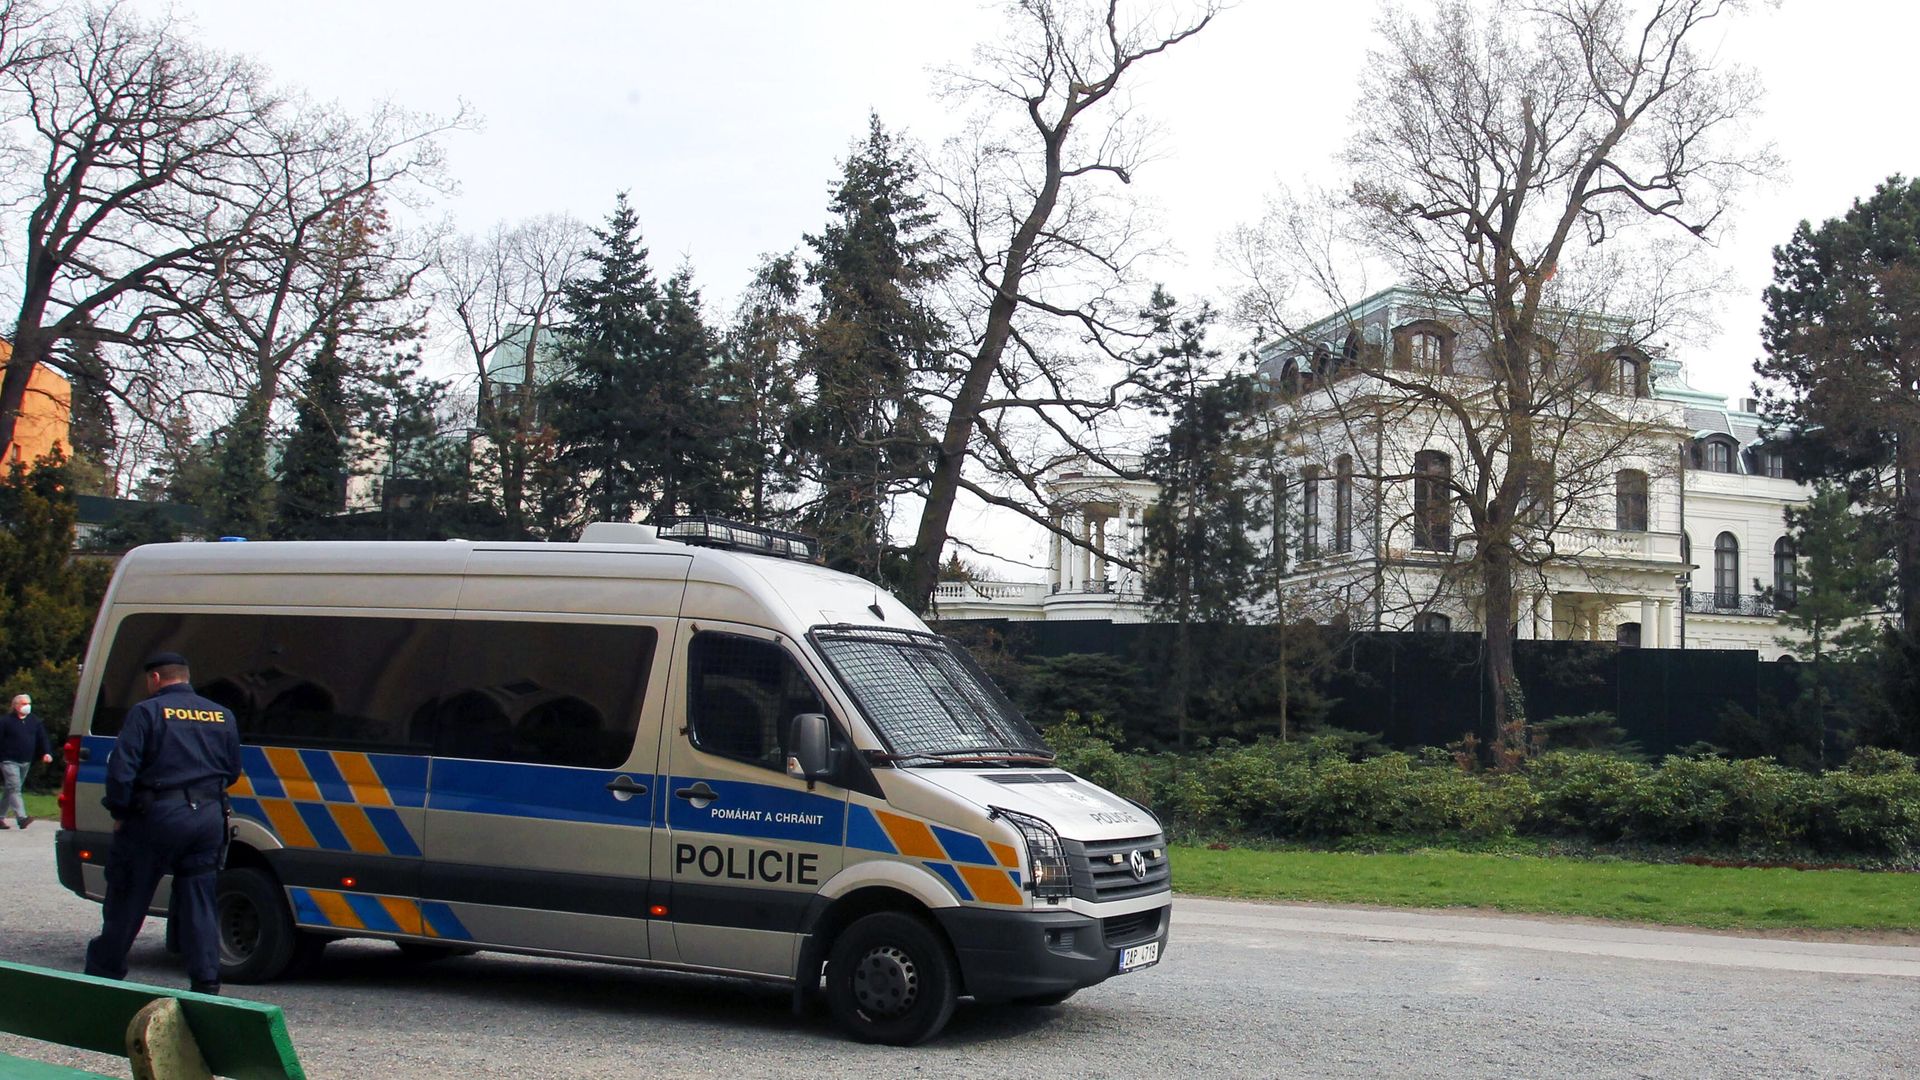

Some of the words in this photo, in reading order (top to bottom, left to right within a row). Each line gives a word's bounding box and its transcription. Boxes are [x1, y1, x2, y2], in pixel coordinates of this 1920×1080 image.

[163, 707, 225, 723] POLICIE
[711, 807, 762, 821] POMÁHAT
[764, 812, 773, 822] A
[775, 811, 824, 825] CHRÁNIT
[1089, 811, 1138, 825] POLICIE
[676, 843, 818, 885] POLICIE
